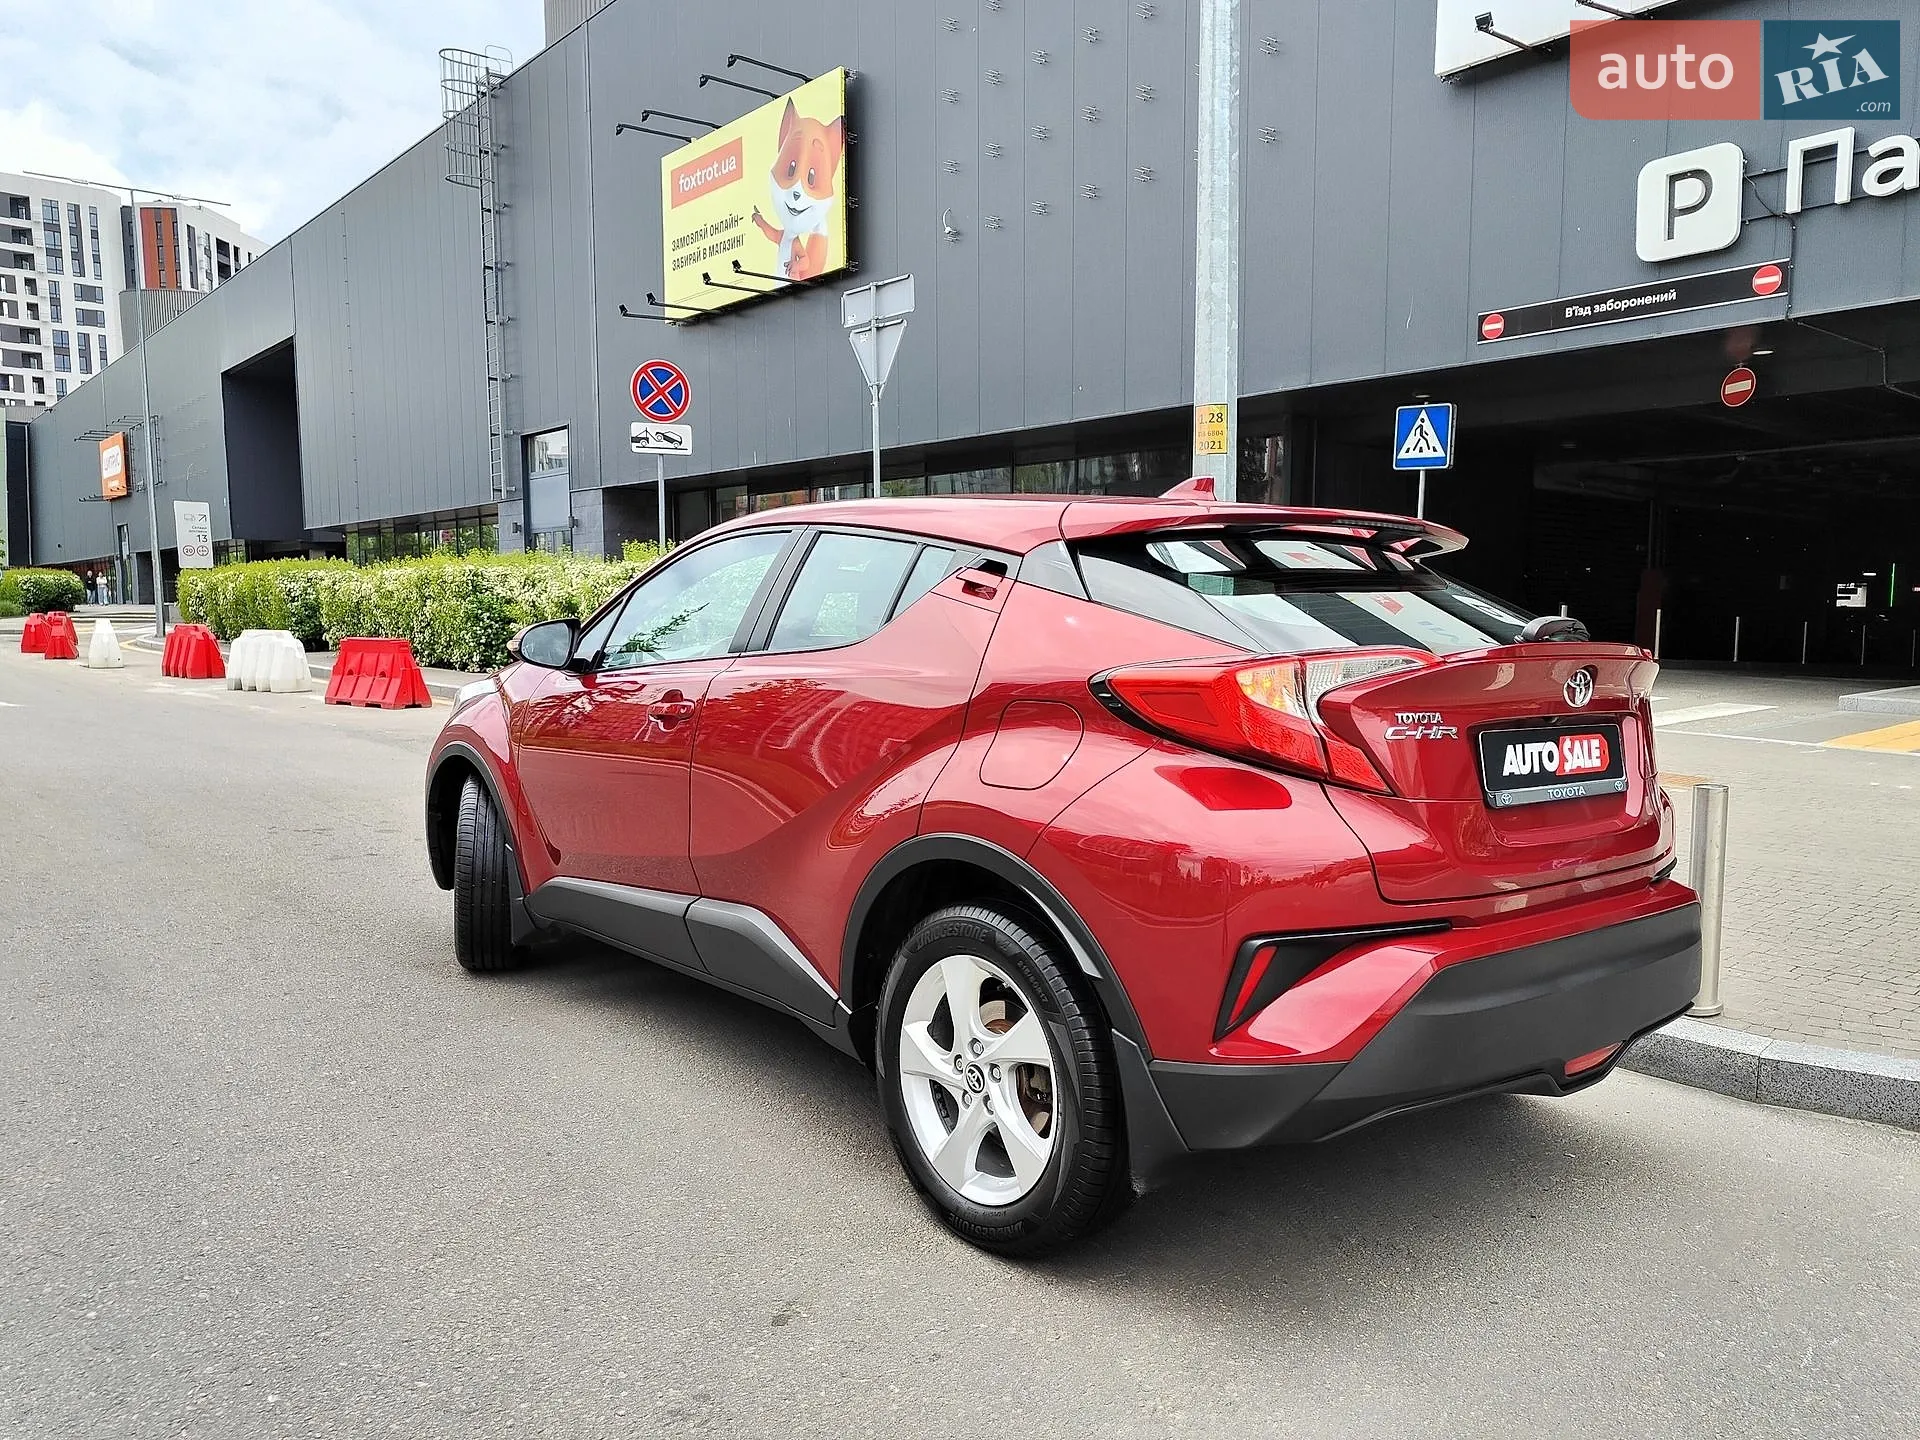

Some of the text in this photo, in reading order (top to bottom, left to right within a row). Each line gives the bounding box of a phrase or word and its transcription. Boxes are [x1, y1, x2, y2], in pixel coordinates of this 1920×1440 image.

[678, 155, 737, 193] foxtrot.ua
[1663, 168, 1713, 242] P
[671, 223, 709, 252] ЗАМОВЛЯЙ
[672, 246, 702, 272] ЗАБИРАЙ
[702, 247, 707, 260] В
[1593, 288, 1677, 313] заборонений
[1199, 412, 1224, 424] 1.28
[1199, 440, 1223, 451] 2021
[196, 534, 208, 543] 13
[1394, 712, 1444, 725] TOYOTA
[1383, 725, 1459, 741] C-HR
[1502, 741, 1560, 777] AUTO
[1547, 785, 1587, 799] TOYOTA
